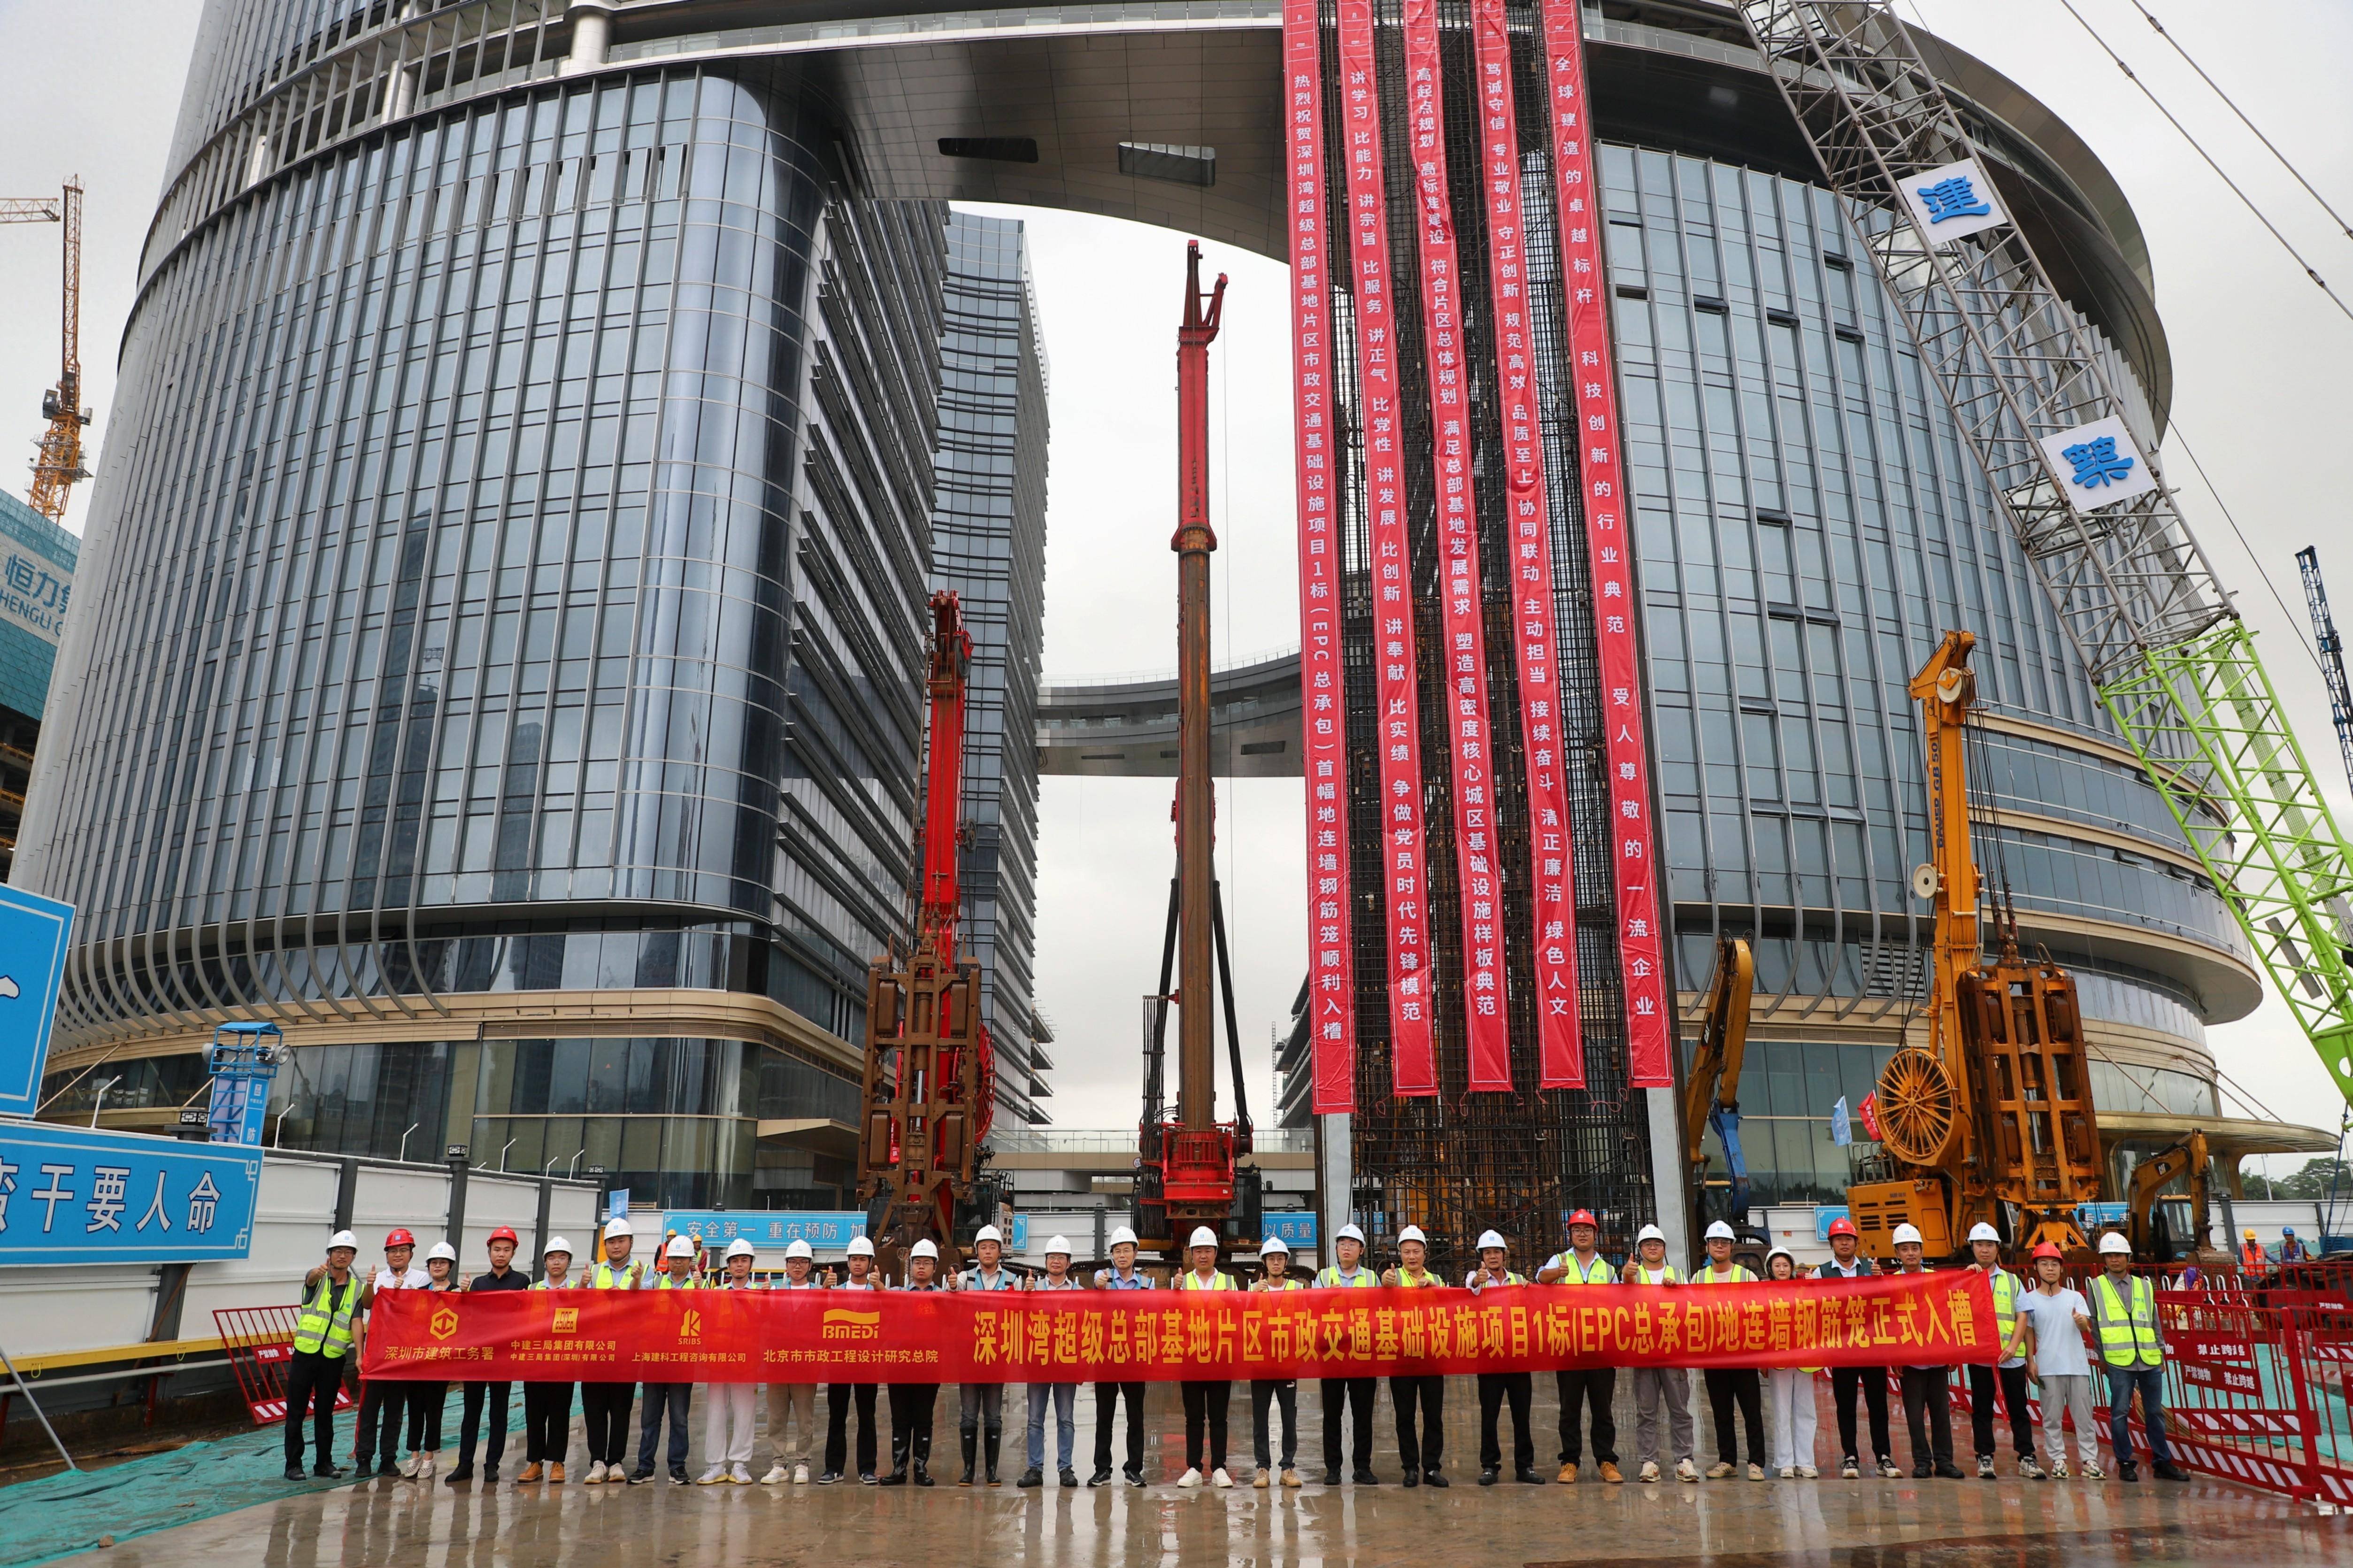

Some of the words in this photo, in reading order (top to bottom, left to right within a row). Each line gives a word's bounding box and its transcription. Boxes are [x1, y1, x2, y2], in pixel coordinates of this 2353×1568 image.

[1350, 70, 1368, 119] 讲学习
[1416, 67, 1435, 147] 高起点规划
[1485, 63, 1506, 130] 笃诚守信
[1354, 131, 1372, 180] 比能力
[1492, 143, 1512, 213] 专业敬业
[1358, 193, 1376, 246] 讲宗旨
[1420, 161, 1446, 245] 高标准建设
[1363, 260, 1382, 314] 比服务
[1498, 226, 1519, 297] 守正创新
[1368, 328, 1388, 382] 讲正气
[1431, 259, 1457, 404] 符合片区总体规划
[1505, 313, 1525, 389] 规范高效
[1373, 397, 1392, 452] 比党性
[1512, 404, 1534, 484] 品质至上
[1376, 467, 1396, 526] 讲发展
[1444, 420, 1471, 615] 满足总部基地发展需求
[1518, 500, 1539, 581] 协同联动
[1555, 57, 1592, 303] 全球建造的卓越标杆
[1582, 350, 1624, 633] 科技创新的行业典范
[1613, 688, 1655, 1015] 受人尊敬的一流企业
[1382, 541, 1400, 601] 比创新
[1385, 618, 1405, 681] 讲奉献
[1524, 598, 1546, 683] 主动担当
[1390, 698, 1409, 761] 比实绩
[1530, 700, 1554, 791] 接续奋斗
[1931, 742, 1939, 763] 50
[1932, 766, 1942, 791] GB
[1455, 633, 1496, 1015] 塑造高密度核心城区基础设施样板典范
[1541, 808, 1561, 902] 清正廉洁
[1392, 779, 1421, 1020] 争做党员时代先锋模范
[1545, 921, 1567, 1015] 绿色人文
[686, 1220, 757, 1238] 安全第一
[768, 1222, 838, 1240] 重在预防
[1264, 1222, 1312, 1238] 以质量
[384, 1346, 494, 1360] 深圳市建筑工务署
[510, 1339, 616, 1351] 中建三局集团有限公司
[510, 1353, 615, 1362] 中建三局集团(深圳)有限公司
[631, 1352, 746, 1362] 上海建科工程咨询有限公司
[763, 1349, 939, 1363] 北京市市政工程设计研究总院
[2184, 1364, 2212, 1382] 严禁抛物
[2223, 1371, 2255, 1390] 禁止跨越
